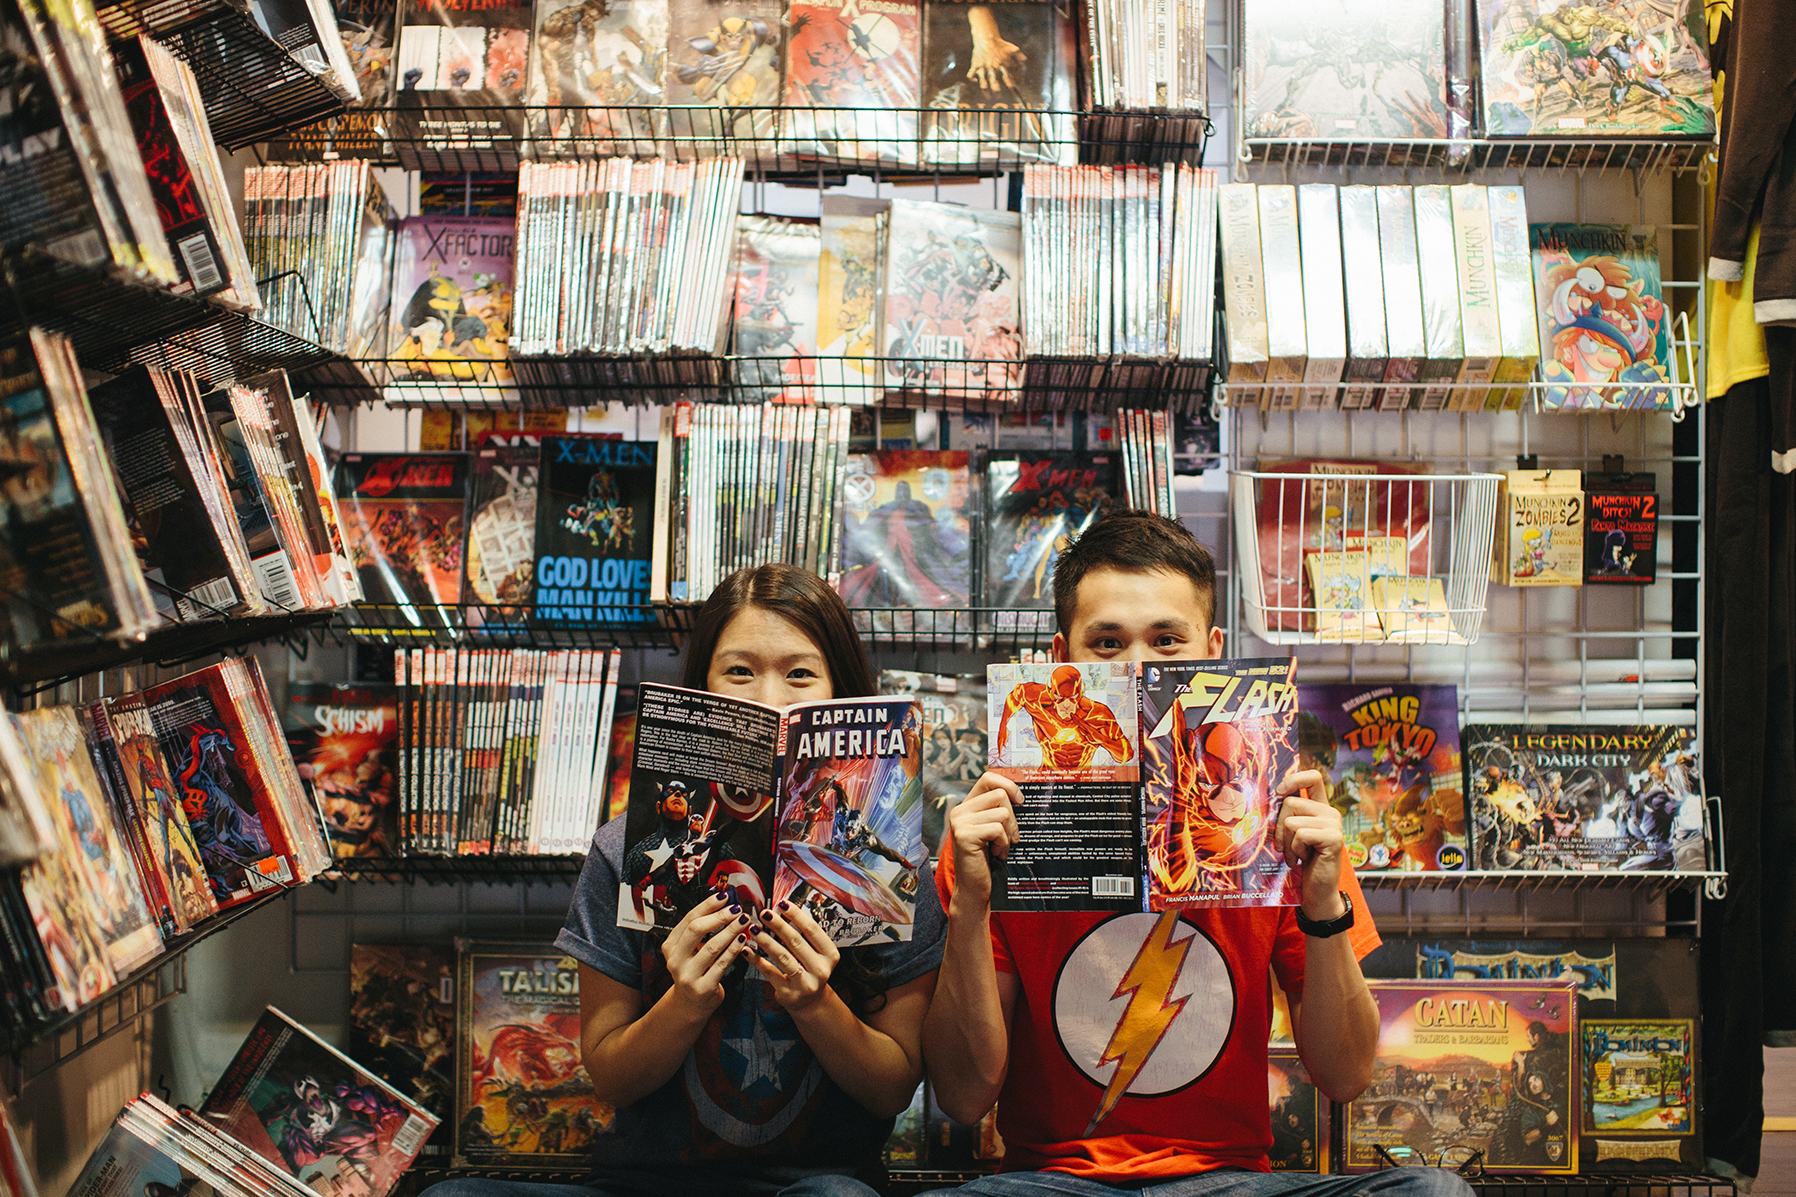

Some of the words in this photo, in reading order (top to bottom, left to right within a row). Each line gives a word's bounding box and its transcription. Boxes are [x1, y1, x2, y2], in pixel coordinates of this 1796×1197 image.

[859, 1, 917, 16] PROGRAM
[1537, 227, 1627, 253] MUNCHKIN
[1466, 226, 1491, 308] MUNCHKIN
[556, 440, 655, 466] X-MEN
[1010, 460, 1097, 491] X-MEN
[1515, 496, 1567, 510] MUNCHKIN
[1566, 497, 1581, 527] 2
[1515, 509, 1567, 527] ZOMBIES
[1592, 495, 1641, 510] MUNCHKIN
[1641, 495, 1655, 519] 2
[796, 517, 806, 549] COMPLEX
[537, 556, 588, 588] GOD
[1248, 667, 1269, 676] NEW
[1269, 665, 1289, 675] 52!
[314, 705, 384, 737] SCHISM
[812, 708, 888, 726] CAPTAIN
[1148, 672, 1296, 739] FLASH
[1351, 695, 1420, 727] KING
[777, 718, 788, 755] MARVEL
[797, 729, 907, 760] AMERICA
[1343, 721, 1437, 758] TOKYO
[1512, 734, 1653, 750] LEGENDARY
[1537, 753, 1589, 767] DARK
[1591, 753, 1631, 767] CITY
[847, 915, 881, 926] REBORN
[1414, 997, 1509, 1029] CATAN
[1414, 1035, 1450, 1045] TRADERS
[1458, 1035, 1509, 1045] BARBARIANS
